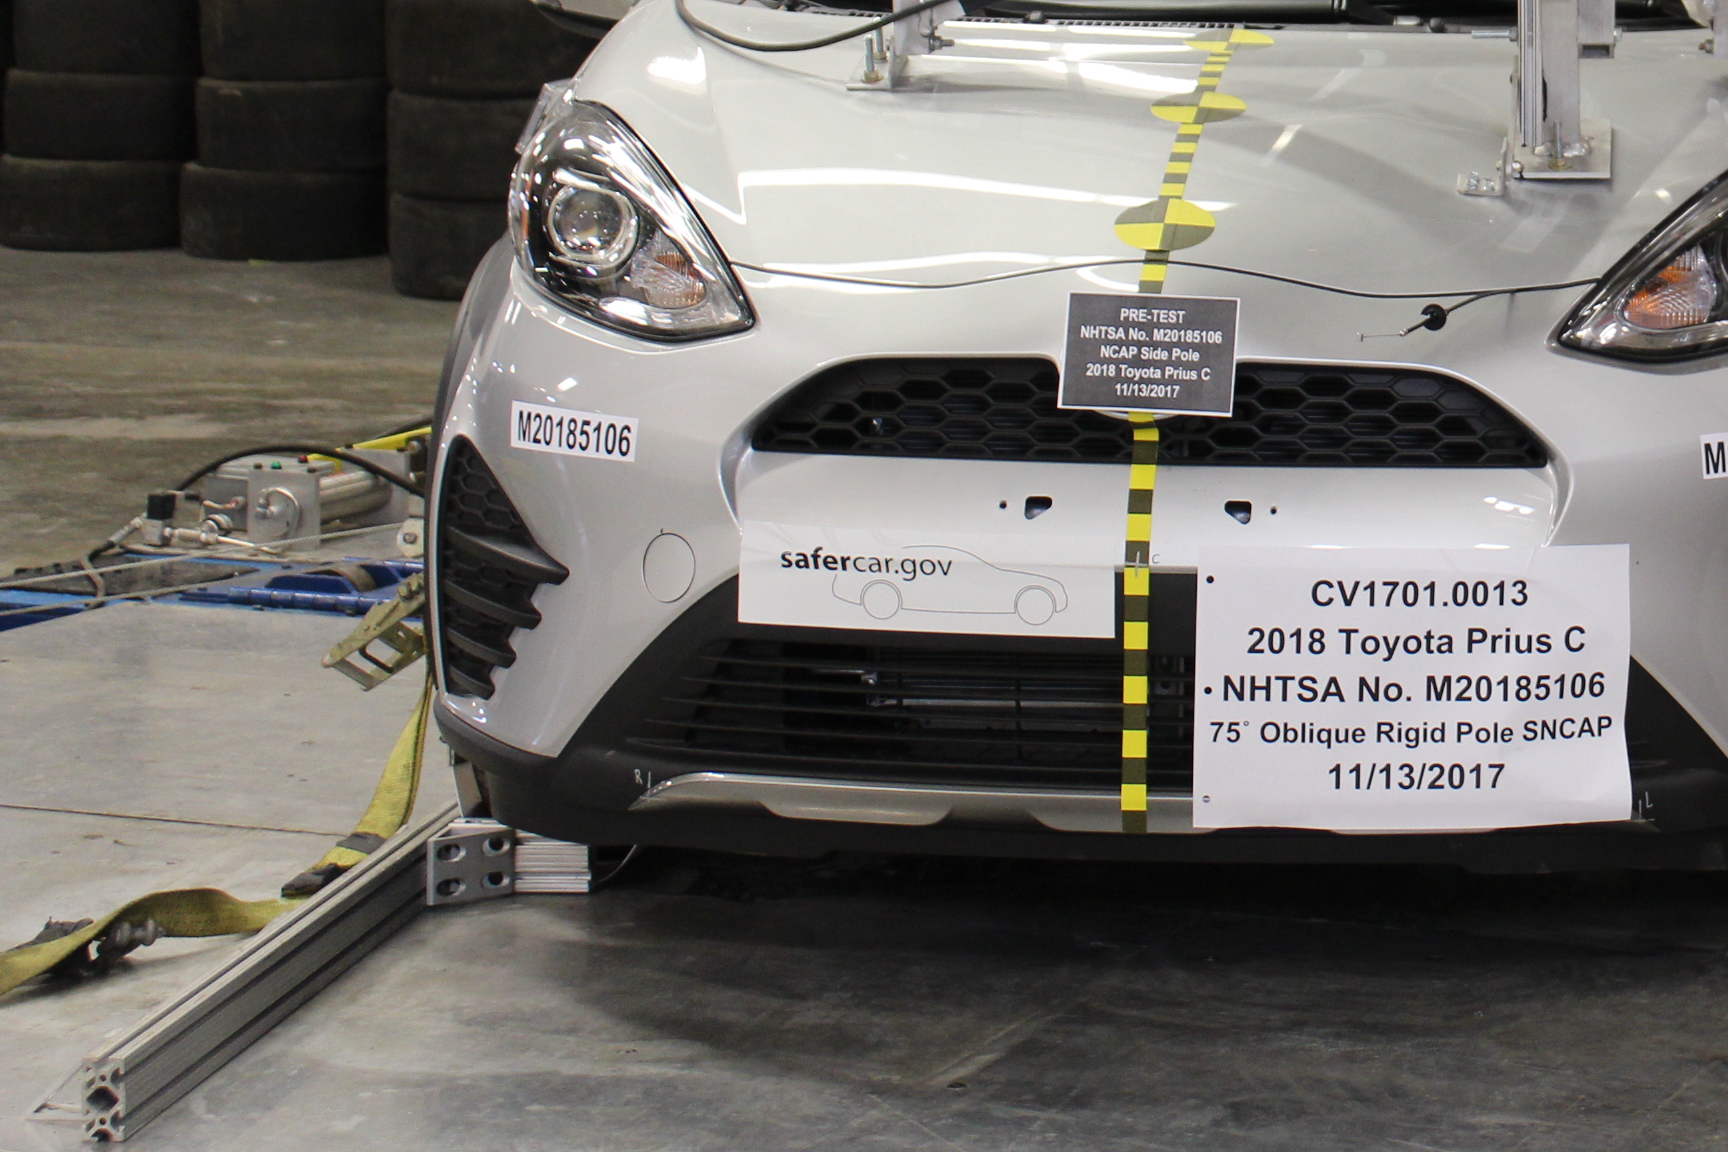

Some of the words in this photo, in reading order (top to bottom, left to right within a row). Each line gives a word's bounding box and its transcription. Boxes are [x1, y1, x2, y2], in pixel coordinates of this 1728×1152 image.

[1120, 307, 1186, 324] PRE-TEST
[1080, 325, 1126, 340] NHTSA
[1128, 327, 1150, 341] No.
[1152, 328, 1223, 344] M20185106
[1099, 344, 1138, 359] NCAP
[1140, 346, 1169, 361] Side
[1171, 347, 1200, 362] Pole
[1085, 362, 1116, 377] 2018
[1119, 363, 1162, 381] Toyota
[1164, 366, 1198, 381] Prius
[1200, 367, 1211, 381] C
[1114, 382, 1181, 398] 11/13/2017
[517, 410, 632, 457] M20185106
[781, 547, 951, 581] safercar.gov
[1312, 580, 1527, 607] CV1701.0013
[1248, 628, 1325, 654] 2018
[1339, 629, 1453, 661] Toyota
[1468, 628, 1551, 653] Prius
[1565, 626, 1585, 652] C
[1224, 676, 1345, 702] NHTSA
[1359, 677, 1411, 702] No.
[1427, 672, 1604, 701] M20185106
[1261, 722, 1365, 749] Oblique
[1377, 722, 1445, 748] Rigid
[1457, 722, 1513, 743] Pole
[1523, 716, 1612, 741] SNCAP
[1329, 763, 1504, 789] 11/13/2017
